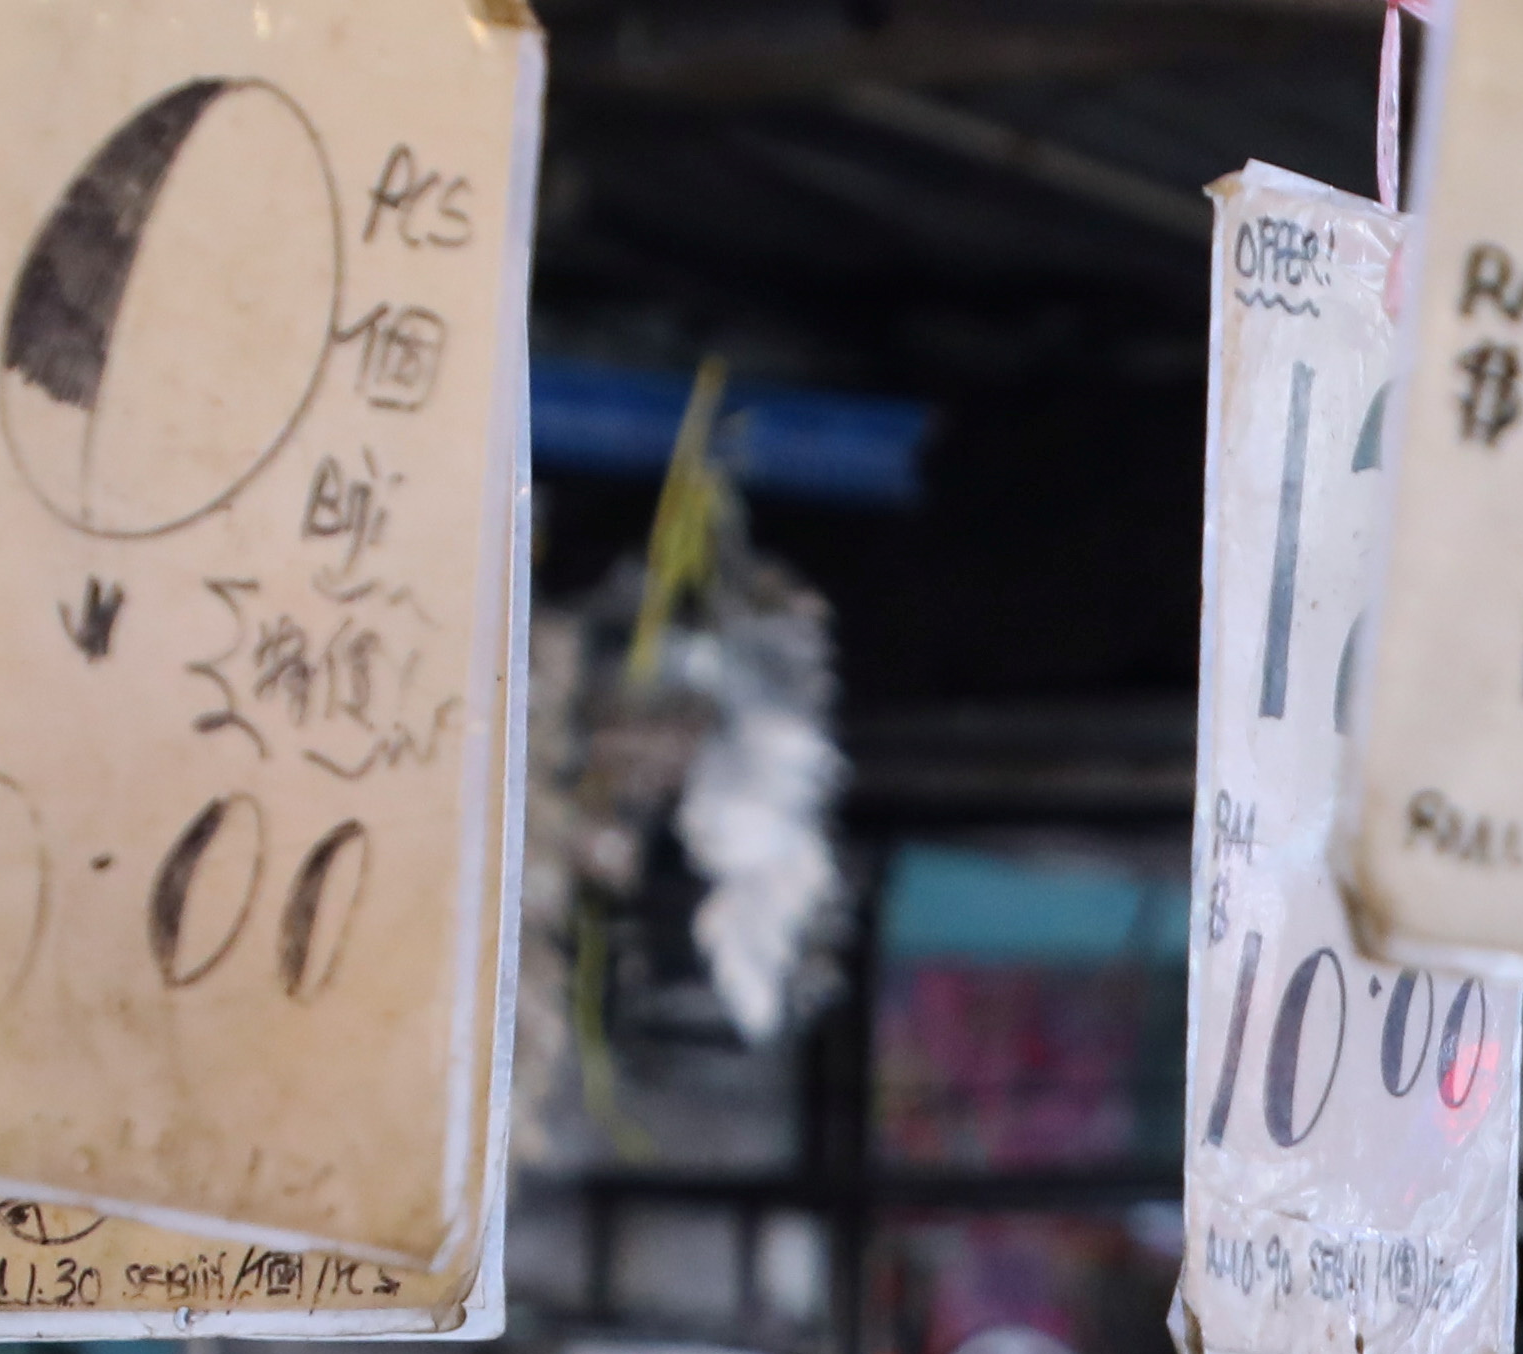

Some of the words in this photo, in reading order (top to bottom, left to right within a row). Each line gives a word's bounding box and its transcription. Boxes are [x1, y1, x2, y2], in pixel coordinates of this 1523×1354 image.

[362, 143, 473, 252] PCS
[1233, 217, 1336, 293] OFFER!
[1201, 930, 1486, 1149] 10.00
